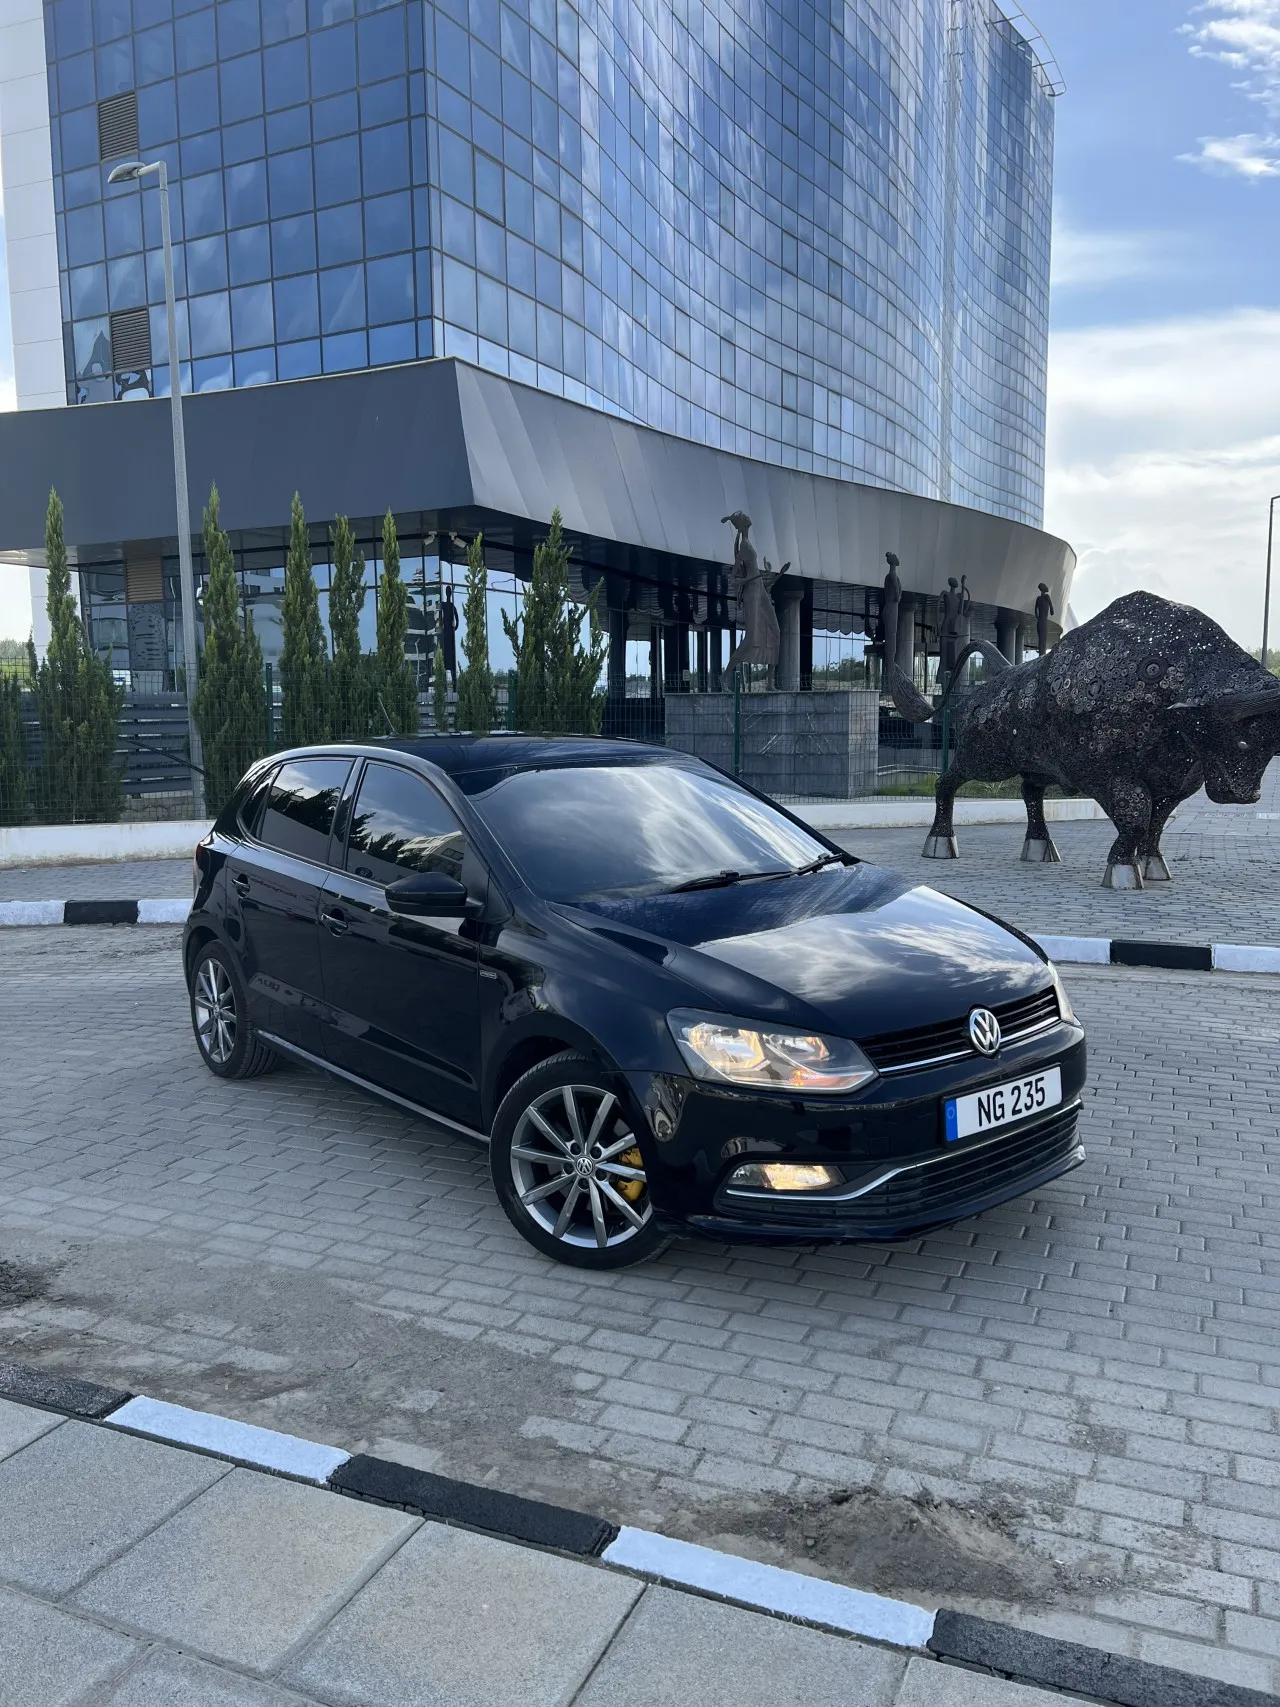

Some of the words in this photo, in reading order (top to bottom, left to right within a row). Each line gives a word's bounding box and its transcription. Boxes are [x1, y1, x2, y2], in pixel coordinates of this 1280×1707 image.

[970, 1009, 1001, 1054] VW
[977, 1090, 1005, 1127] NG
[1011, 1076, 1045, 1117] 235
